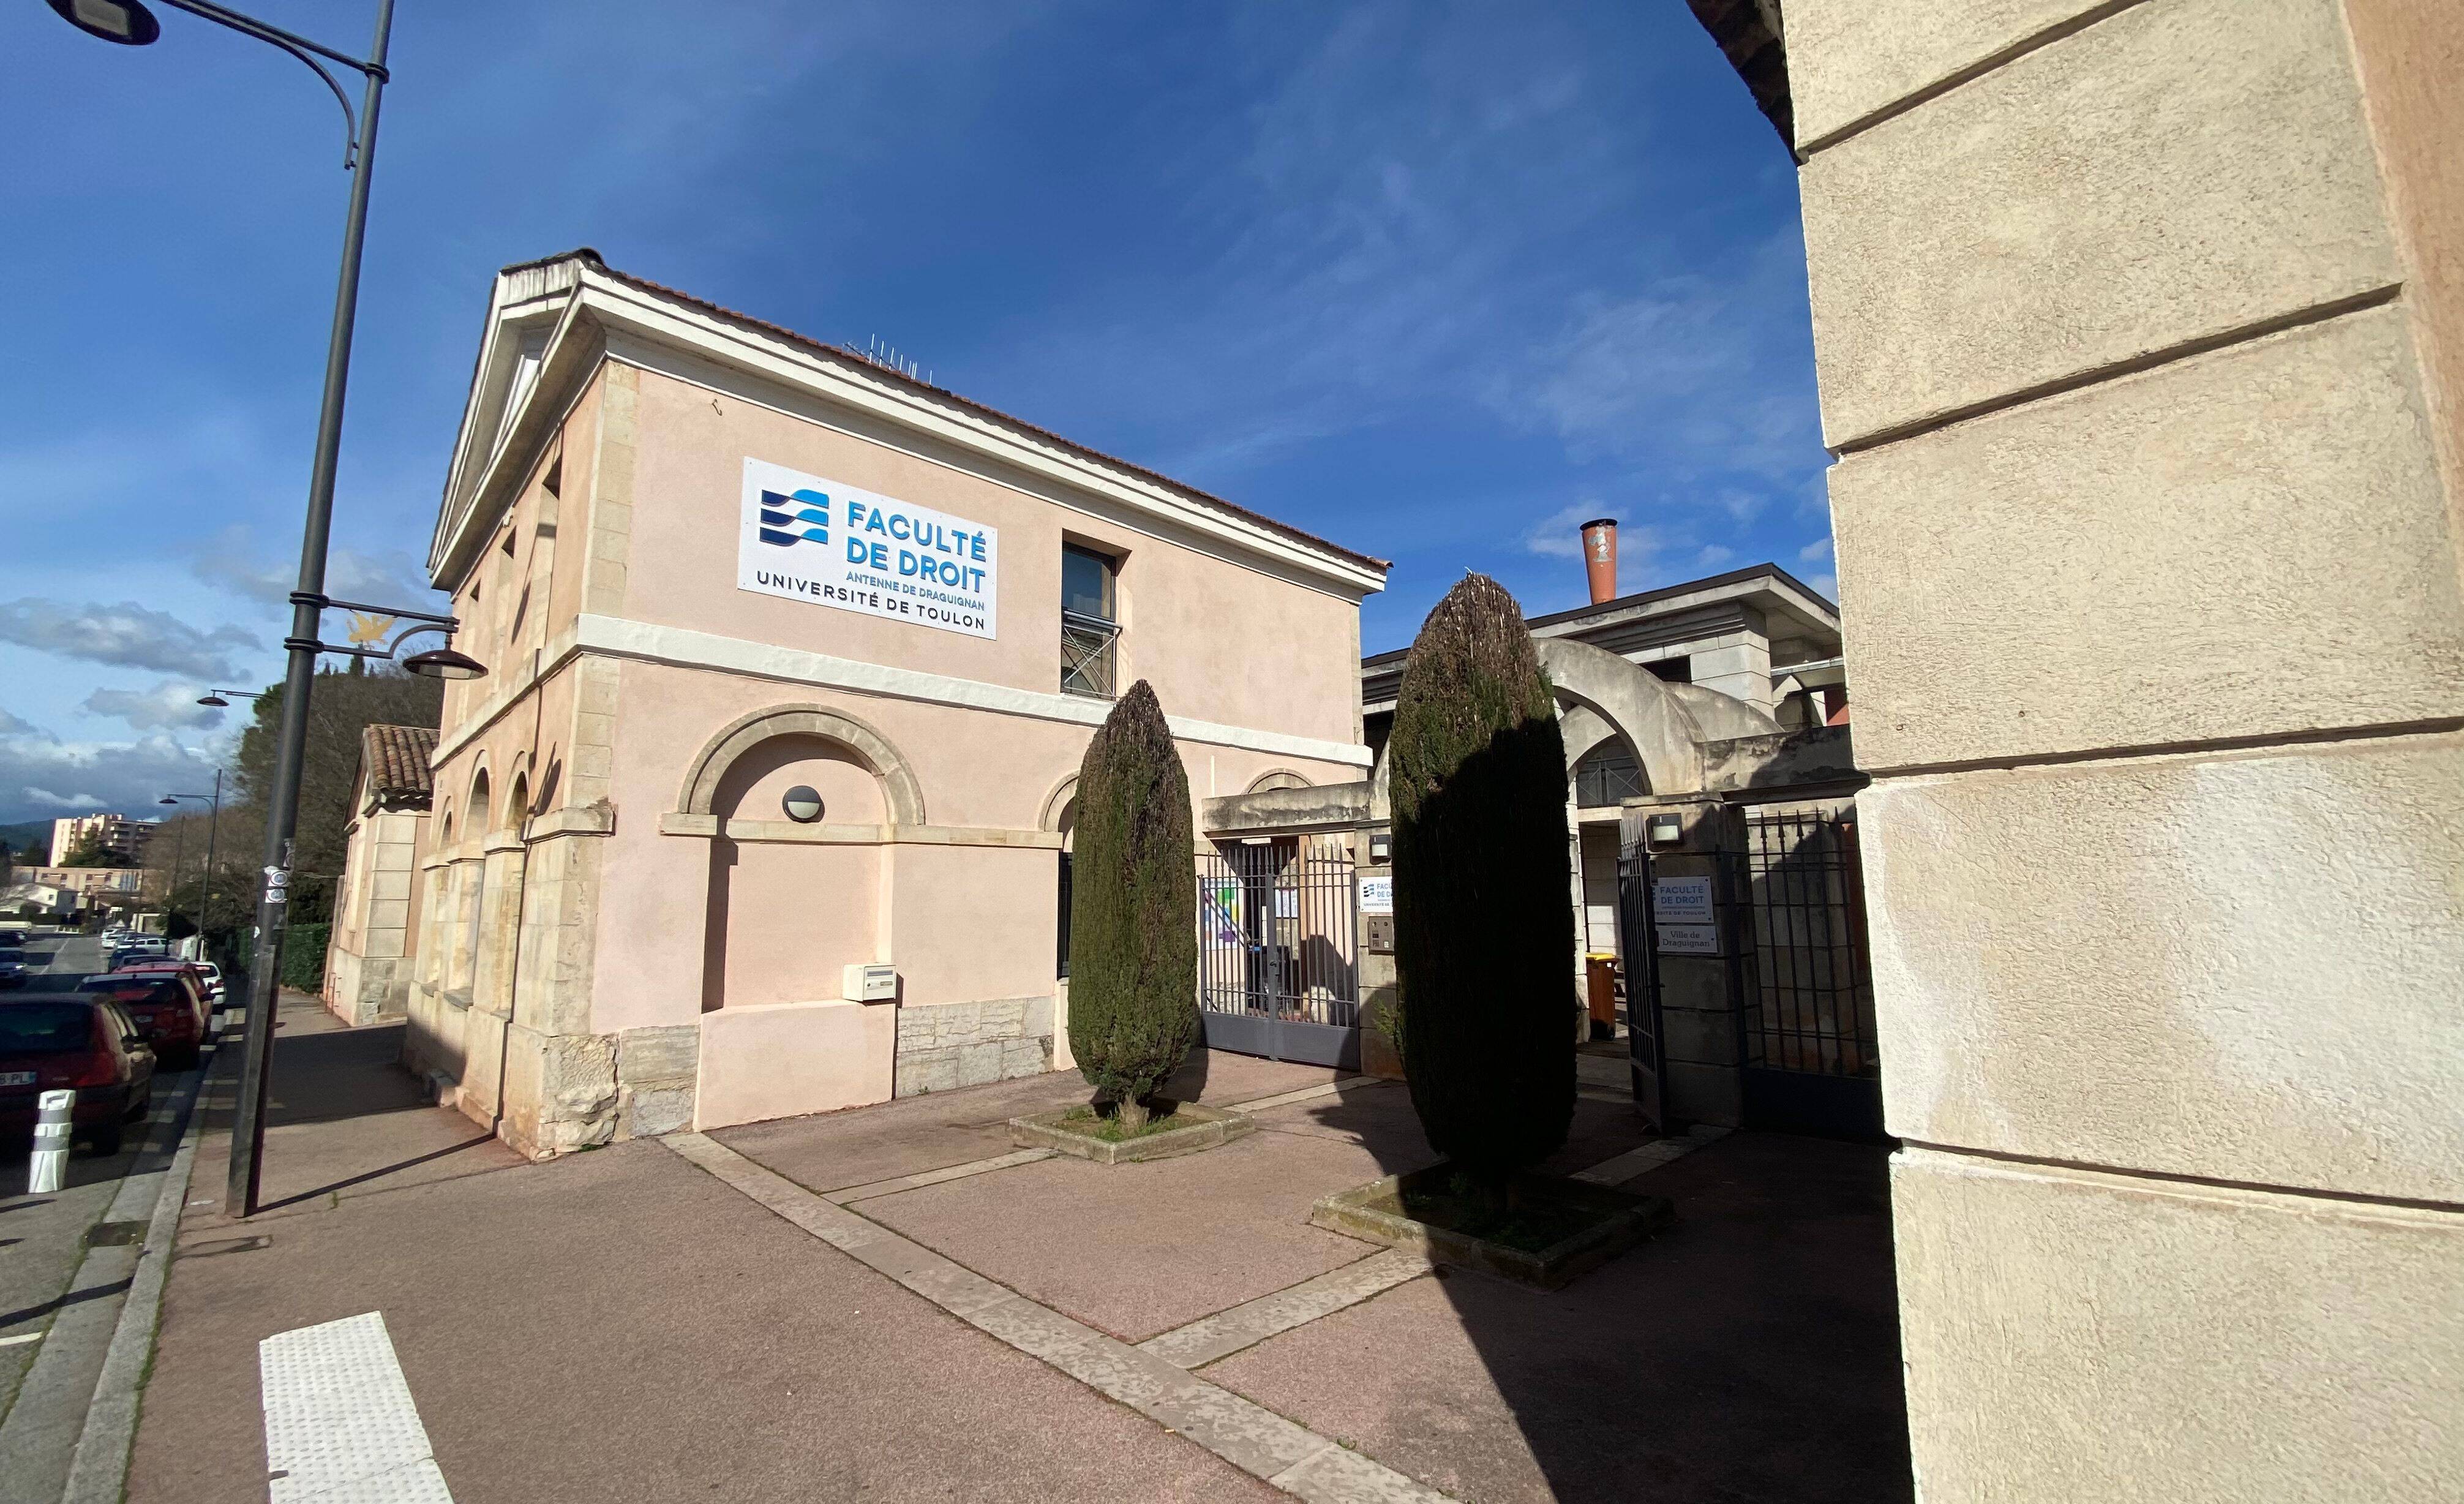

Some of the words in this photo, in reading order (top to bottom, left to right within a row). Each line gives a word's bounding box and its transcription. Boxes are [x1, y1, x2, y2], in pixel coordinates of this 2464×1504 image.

[847, 501, 986, 563] FACULTÉ
[846, 536, 888, 571] DE
[899, 549, 986, 593] DROIT
[757, 570, 879, 607] UNIVERSITÉ
[887, 598, 909, 614] DE
[916, 604, 985, 630] TOULON
[846, 571, 900, 592] ANTENNE
[902, 584, 916, 595] DE
[919, 587, 985, 611] DRAGUIGNAN
[1660, 884, 1704, 894] FACULTÉ
[1675, 895, 1705, 904] DROIT
[1662, 938, 1710, 948] Draguignan
